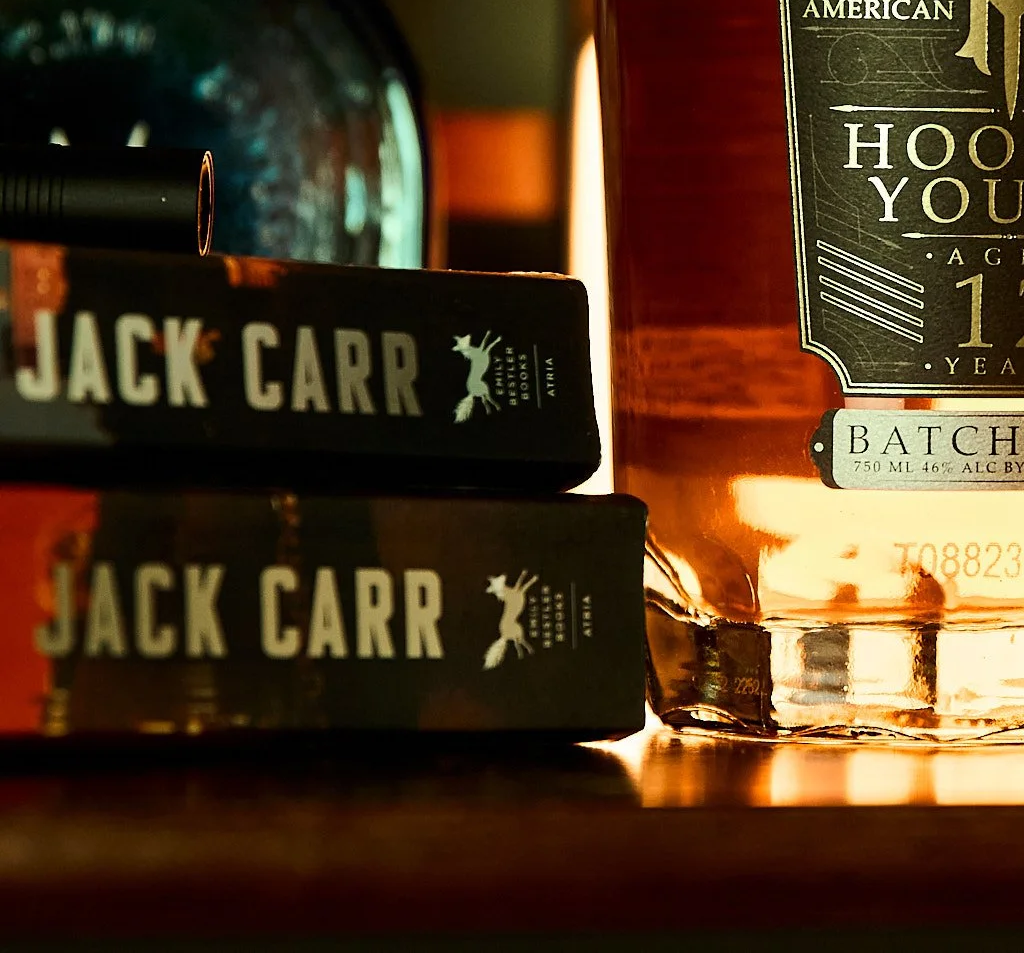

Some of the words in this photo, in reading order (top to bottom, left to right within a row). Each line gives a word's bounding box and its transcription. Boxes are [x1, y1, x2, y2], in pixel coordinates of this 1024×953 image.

[14, 309, 209, 409] JACK
[241, 320, 424, 417] CARR
[493, 355, 505, 396] EMILY
[505, 346, 518, 406] BESTLER
[518, 354, 530, 400] BOOKS
[545, 357, 556, 397] ATRIA
[848, 425, 1019, 456] BATCH
[854, 461, 880, 473] 750
[889, 461, 913, 473] ML
[922, 461, 953, 474] 46%
[961, 461, 997, 473] ALC
[1004, 461, 1024, 473] BY
[32, 561, 227, 660] JACK
[259, 565, 444, 660] CARR
